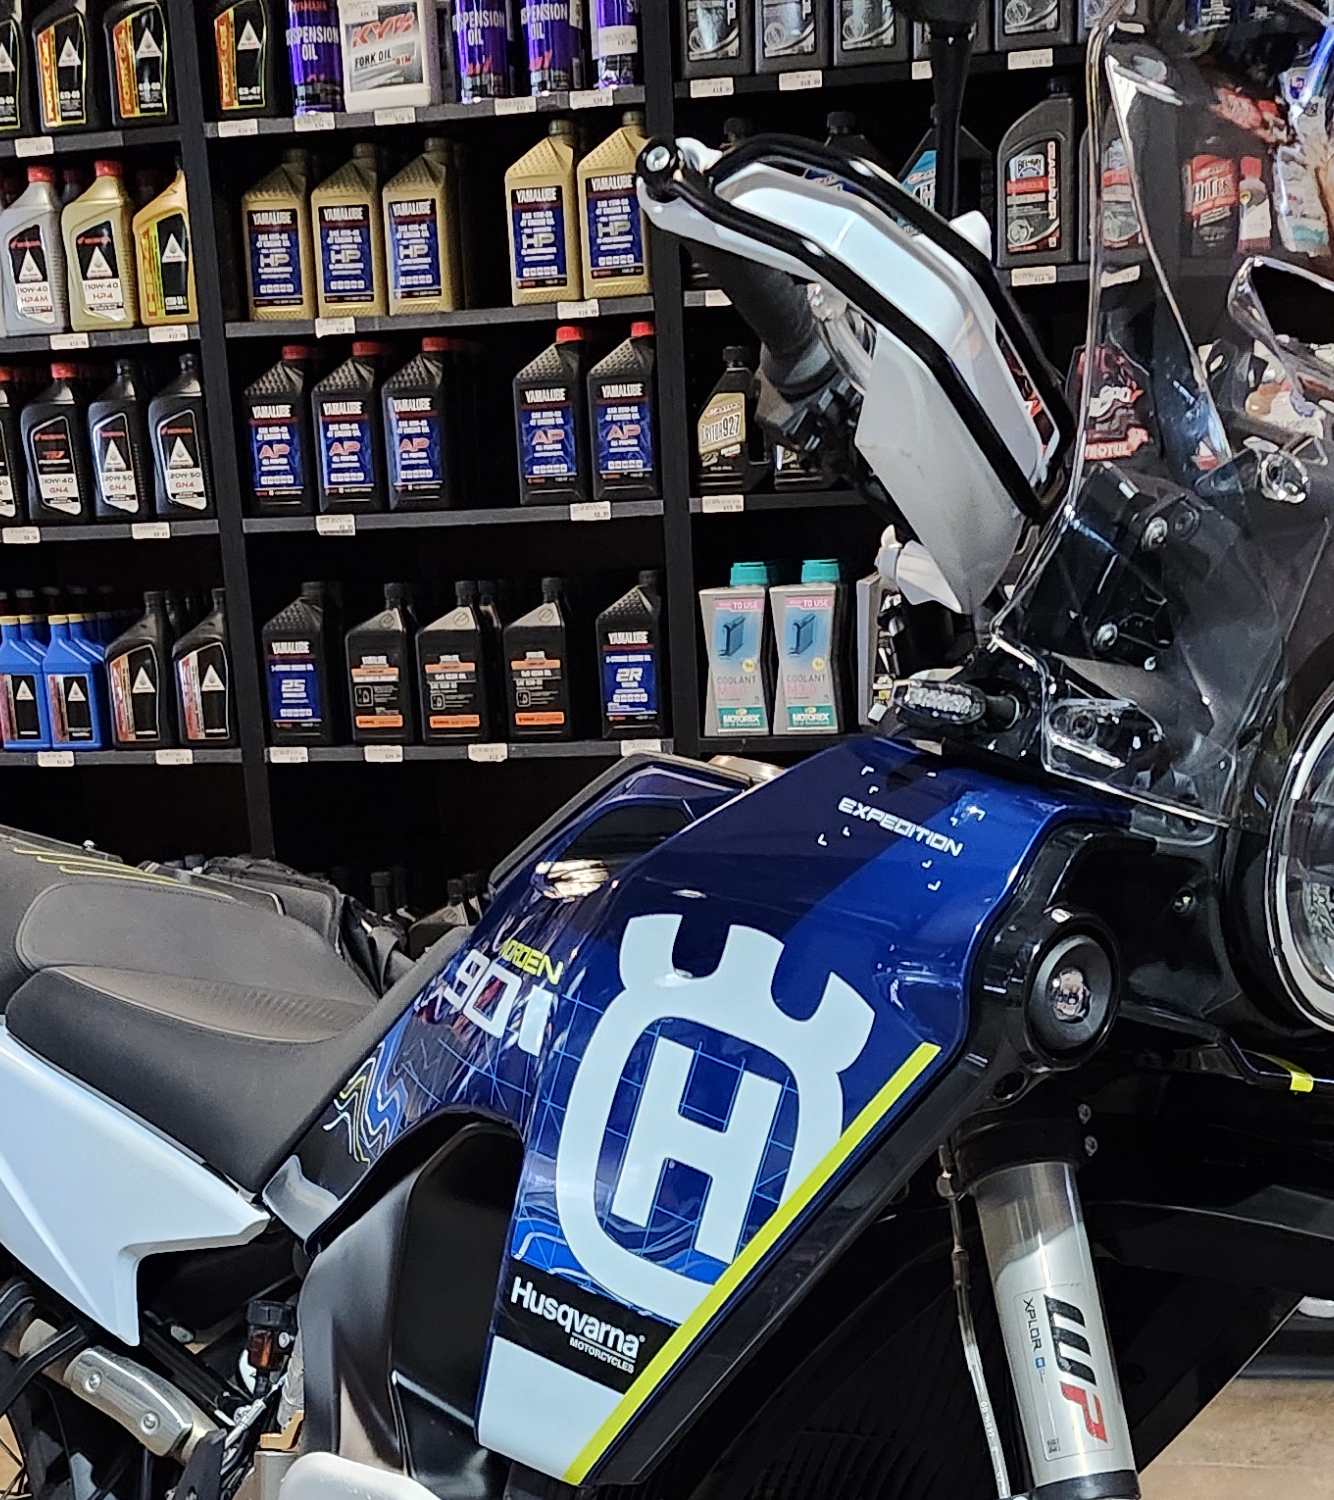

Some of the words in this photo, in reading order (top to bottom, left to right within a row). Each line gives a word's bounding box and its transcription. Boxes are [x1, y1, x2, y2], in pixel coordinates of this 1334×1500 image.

[351, 12, 414, 48] KYB
[468, 28, 484, 46] OIL
[530, 23, 544, 40] OIL
[302, 46, 318, 61] OIL
[354, 53, 376, 67] FORK
[379, 50, 392, 63] OIL
[591, 175, 633, 191] YAMALUBE
[516, 188, 557, 203] YAMALUBE
[597, 221, 631, 237] HP
[521, 233, 555, 248] HP
[331, 250, 361, 263] HP
[399, 245, 428, 259] HP
[260, 254, 290, 267] HP
[525, 388, 567, 403] YAMALUBE
[601, 383, 643, 398] YAMALUBE
[252, 405, 292, 419] YAMALUBE
[323, 402, 363, 415] YAMALUBE
[393, 398, 432, 411] YAMALUBE
[532, 429, 565, 445] AP
[607, 424, 641, 440] AP
[259, 443, 290, 459] AP
[329, 441, 361, 456] AP
[399, 438, 430, 452] AP
[41, 477, 74, 485] 10W-40
[175, 480, 195, 489] GN4
[49, 486, 69, 494] GN4
[732, 601, 742, 610] TO
[744, 599, 758, 610] USE
[803, 599, 812, 608] TO
[814, 598, 828, 607] USE
[608, 631, 648, 645] YAMALUBE
[615, 668, 643, 682] 2R
[716, 675, 757, 685] COOLANT
[786, 674, 826, 684] COOLANT
[722, 713, 761, 726] MOTOREX
[792, 712, 830, 725] MOTOREX
[837, 797, 963, 857] EXPEDITION
[500, 937, 564, 984] NORDEN
[442, 948, 556, 1057] 901
[510, 1276, 640, 1358] Husqvarna
[1022, 1295, 1043, 1353] XPLOR
[569, 1337, 635, 1374] MOTORCYCLES
